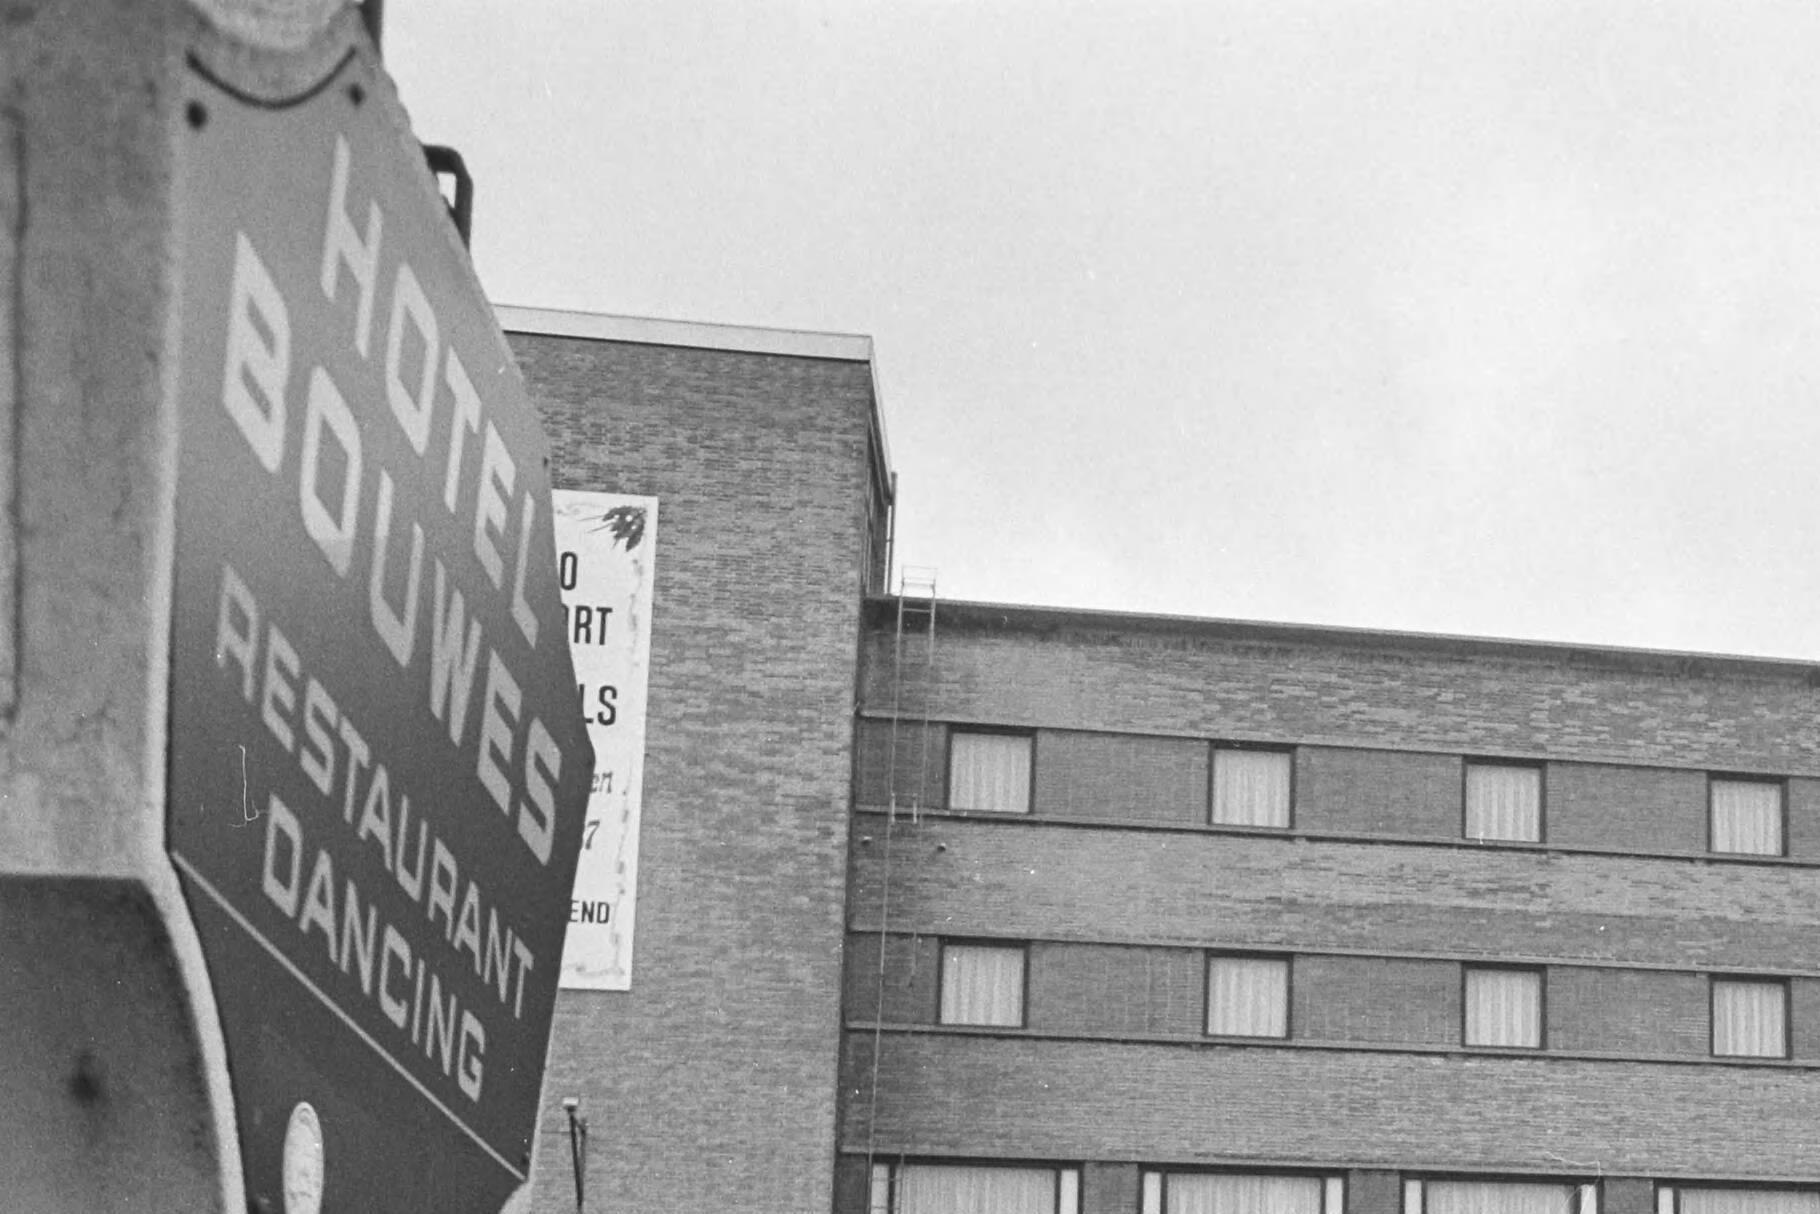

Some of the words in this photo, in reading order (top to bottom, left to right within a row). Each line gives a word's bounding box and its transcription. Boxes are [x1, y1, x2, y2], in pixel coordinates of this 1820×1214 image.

[223, 231, 561, 866] BOUWES
[321, 132, 538, 649] HOTEL
[217, 563, 534, 1019] RESTAURANT
[262, 794, 486, 1102] DANCING
